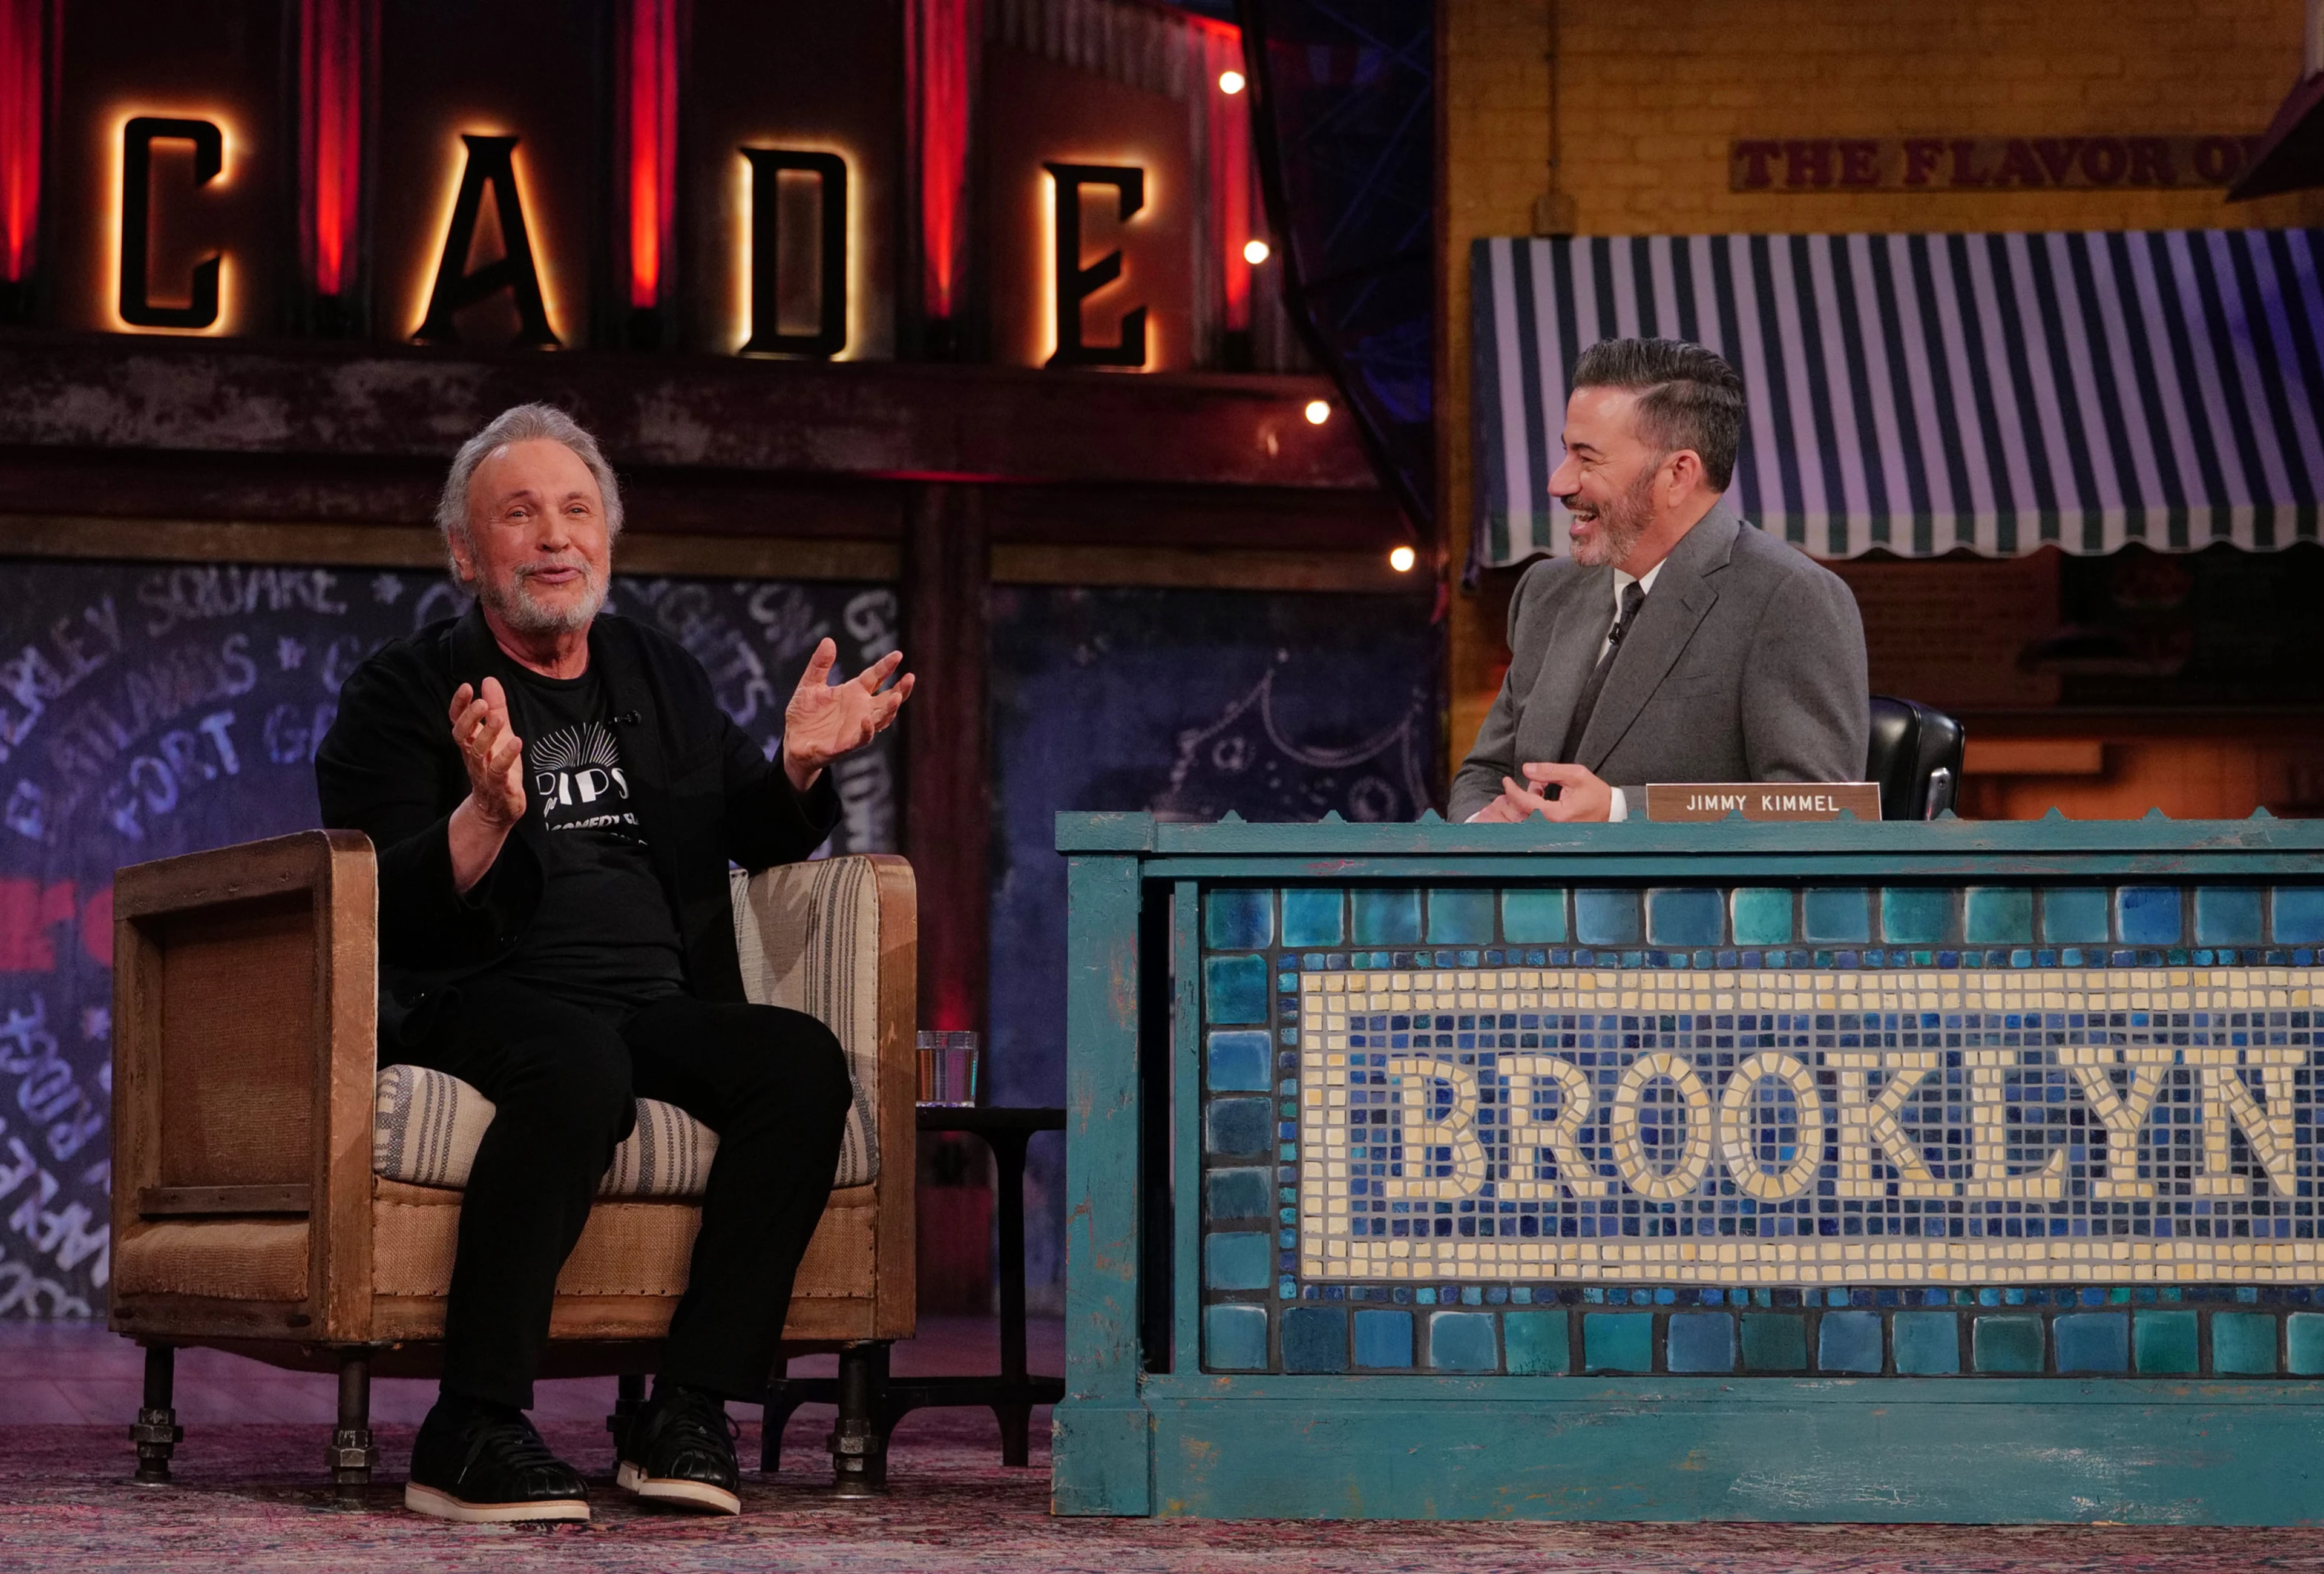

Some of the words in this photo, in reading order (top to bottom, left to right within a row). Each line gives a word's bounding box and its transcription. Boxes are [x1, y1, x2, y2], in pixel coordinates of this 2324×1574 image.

[1735, 139, 1881, 187] THE
[1902, 137, 2179, 188] FLAVOR
[119, 115, 1146, 369] CADE
[137, 565, 348, 637] SQUARE
[1686, 795, 1747, 811] JIMMY
[1762, 795, 1840, 812] KIMMEL
[1385, 1047, 2306, 1200] BROOKLYN
